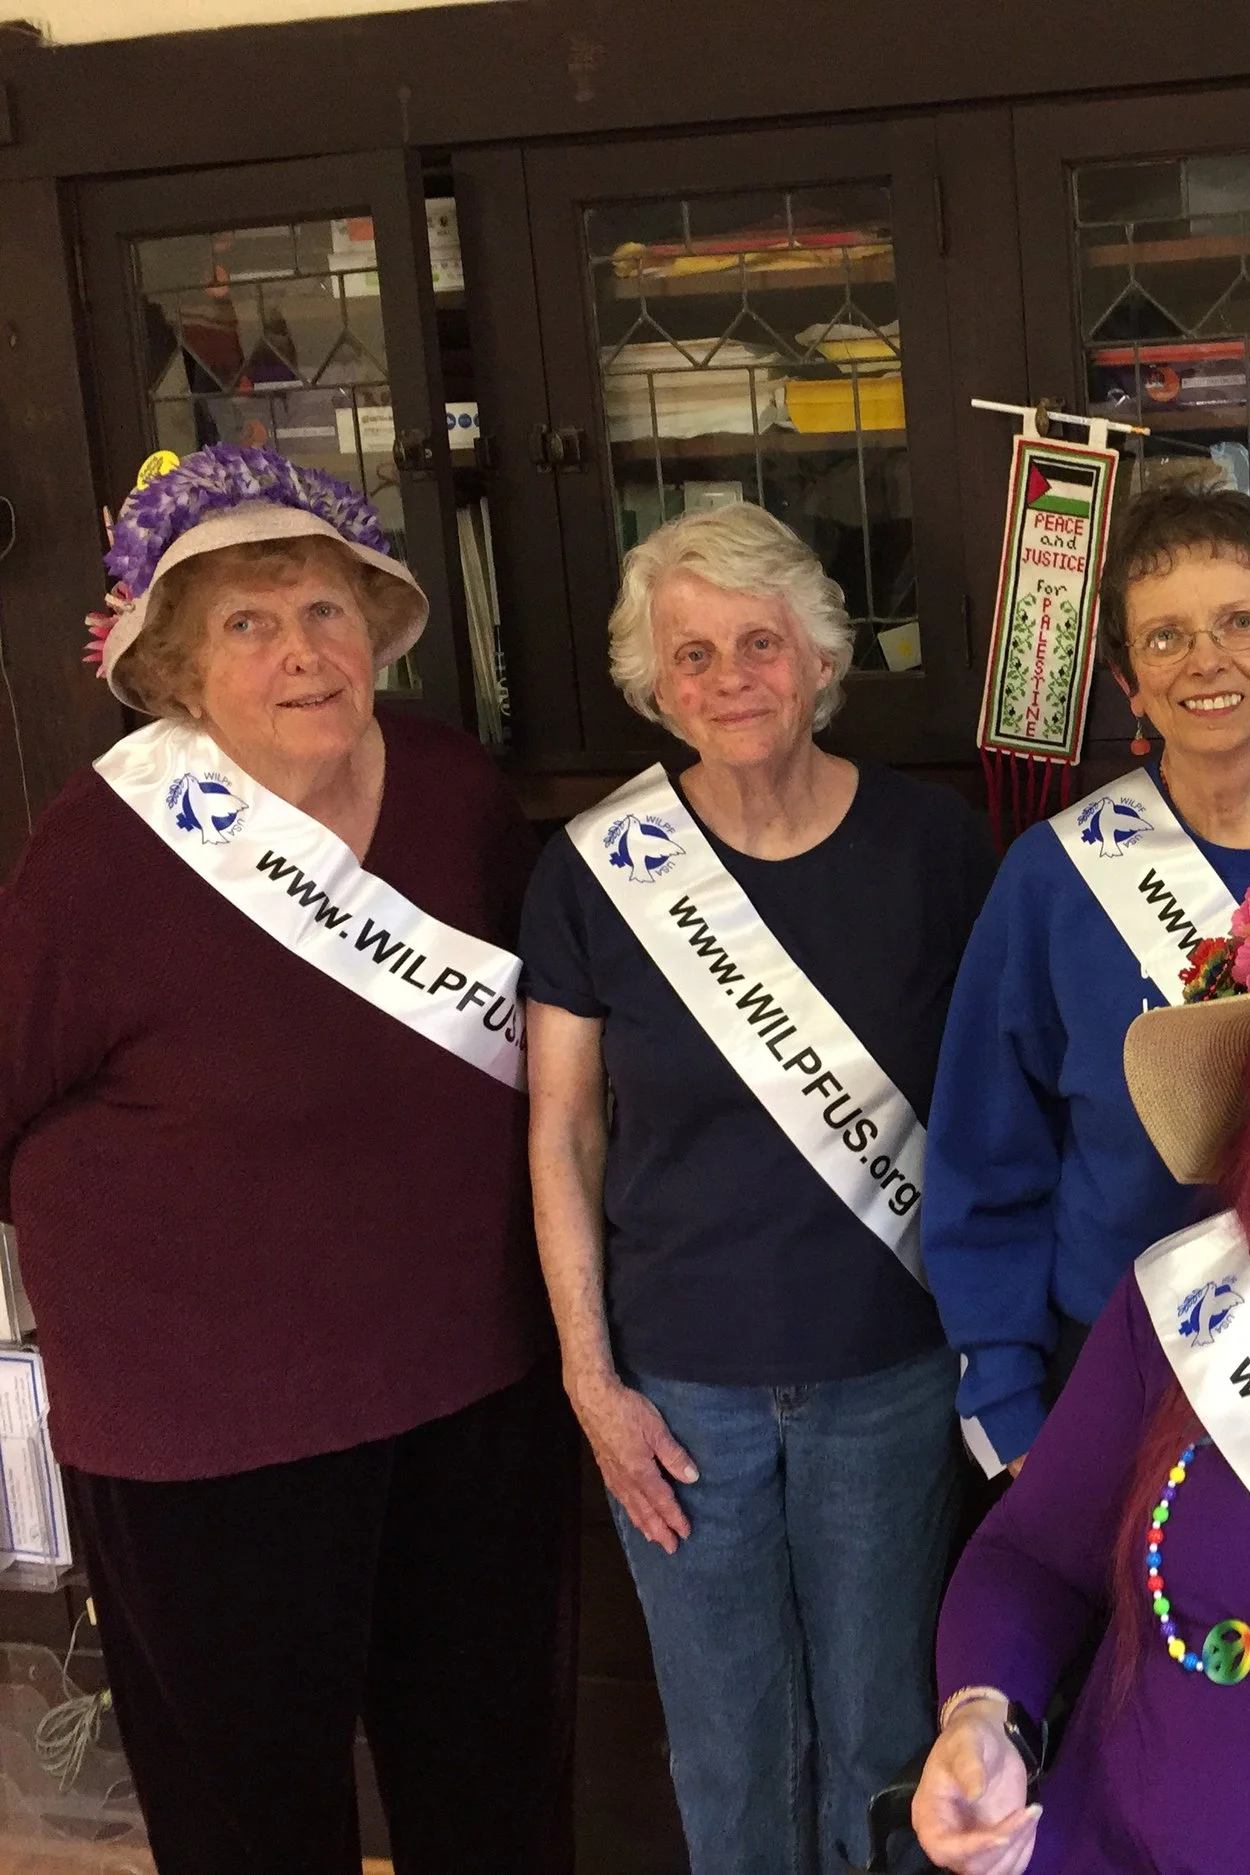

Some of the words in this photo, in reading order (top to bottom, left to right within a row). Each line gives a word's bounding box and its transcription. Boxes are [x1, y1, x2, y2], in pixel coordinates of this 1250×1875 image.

[1034, 513, 1084, 536] PEACE
[1040, 535, 1076, 555] and
[1022, 547, 1085, 573] JUSTICE
[1025, 597, 1052, 738] PALESTINE
[204, 771, 233, 788] WILPF
[1120, 796, 1147, 813] WILPF
[226, 817, 245, 837] USA
[645, 815, 676, 835] WILPF
[1122, 834, 1143, 849] USA
[655, 860, 676, 877] USA
[668, 895, 922, 1216] www.WILPFUS.org
